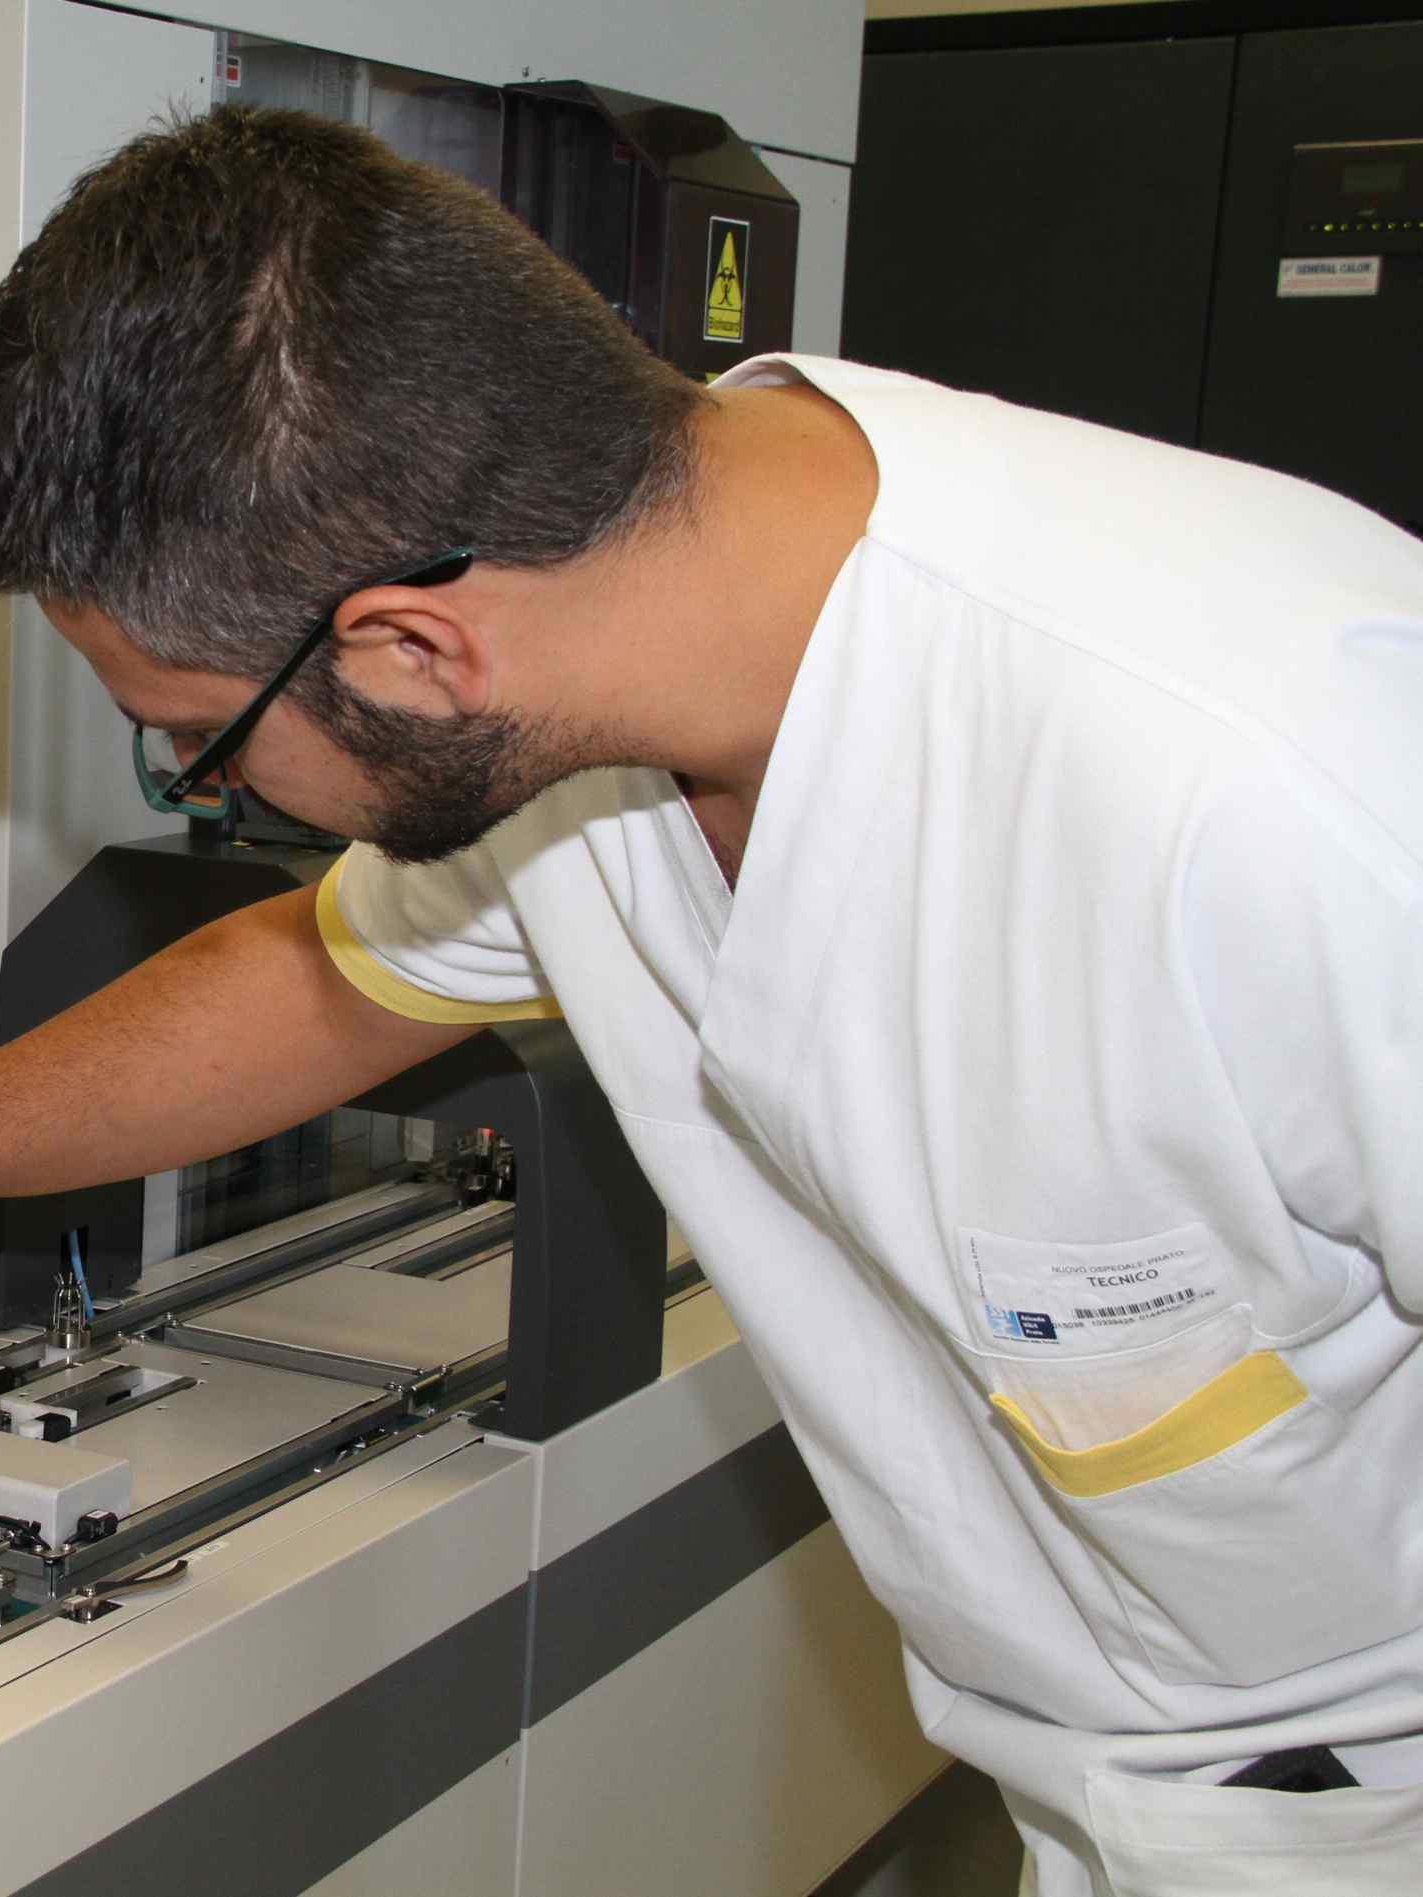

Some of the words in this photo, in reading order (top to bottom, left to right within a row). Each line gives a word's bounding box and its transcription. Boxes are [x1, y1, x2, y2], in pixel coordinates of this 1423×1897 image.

[1051, 1265, 1087, 1274] NUOVO
[1089, 1261, 1145, 1273] OSPEDALE
[1147, 1250, 1185, 1266] PRATO
[1087, 1268, 1159, 1287] TECNICO
